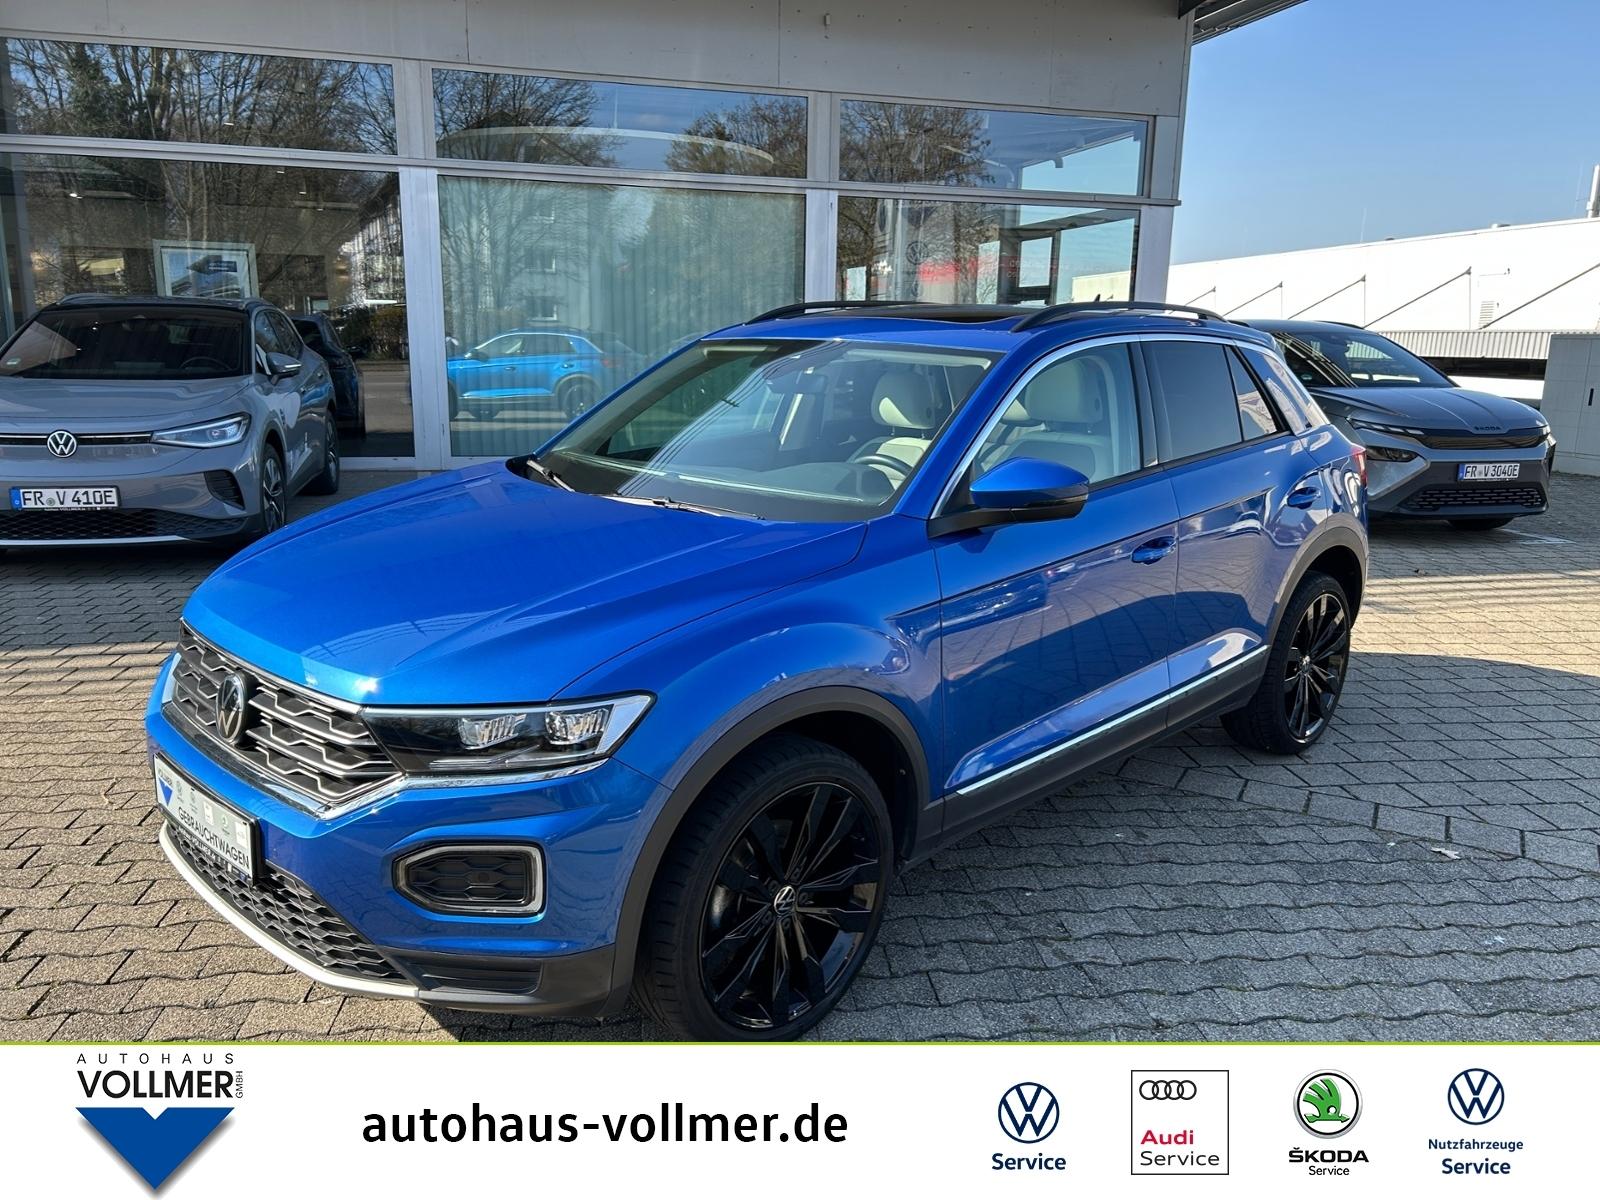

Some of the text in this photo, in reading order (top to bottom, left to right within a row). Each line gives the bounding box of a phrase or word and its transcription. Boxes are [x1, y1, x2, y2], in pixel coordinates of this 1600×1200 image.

[1465, 464, 1518, 477] FR V 3040E
[22, 490, 115, 506] FR V 410E
[178, 806, 250, 869] GEBRAUCHTWAGEN
